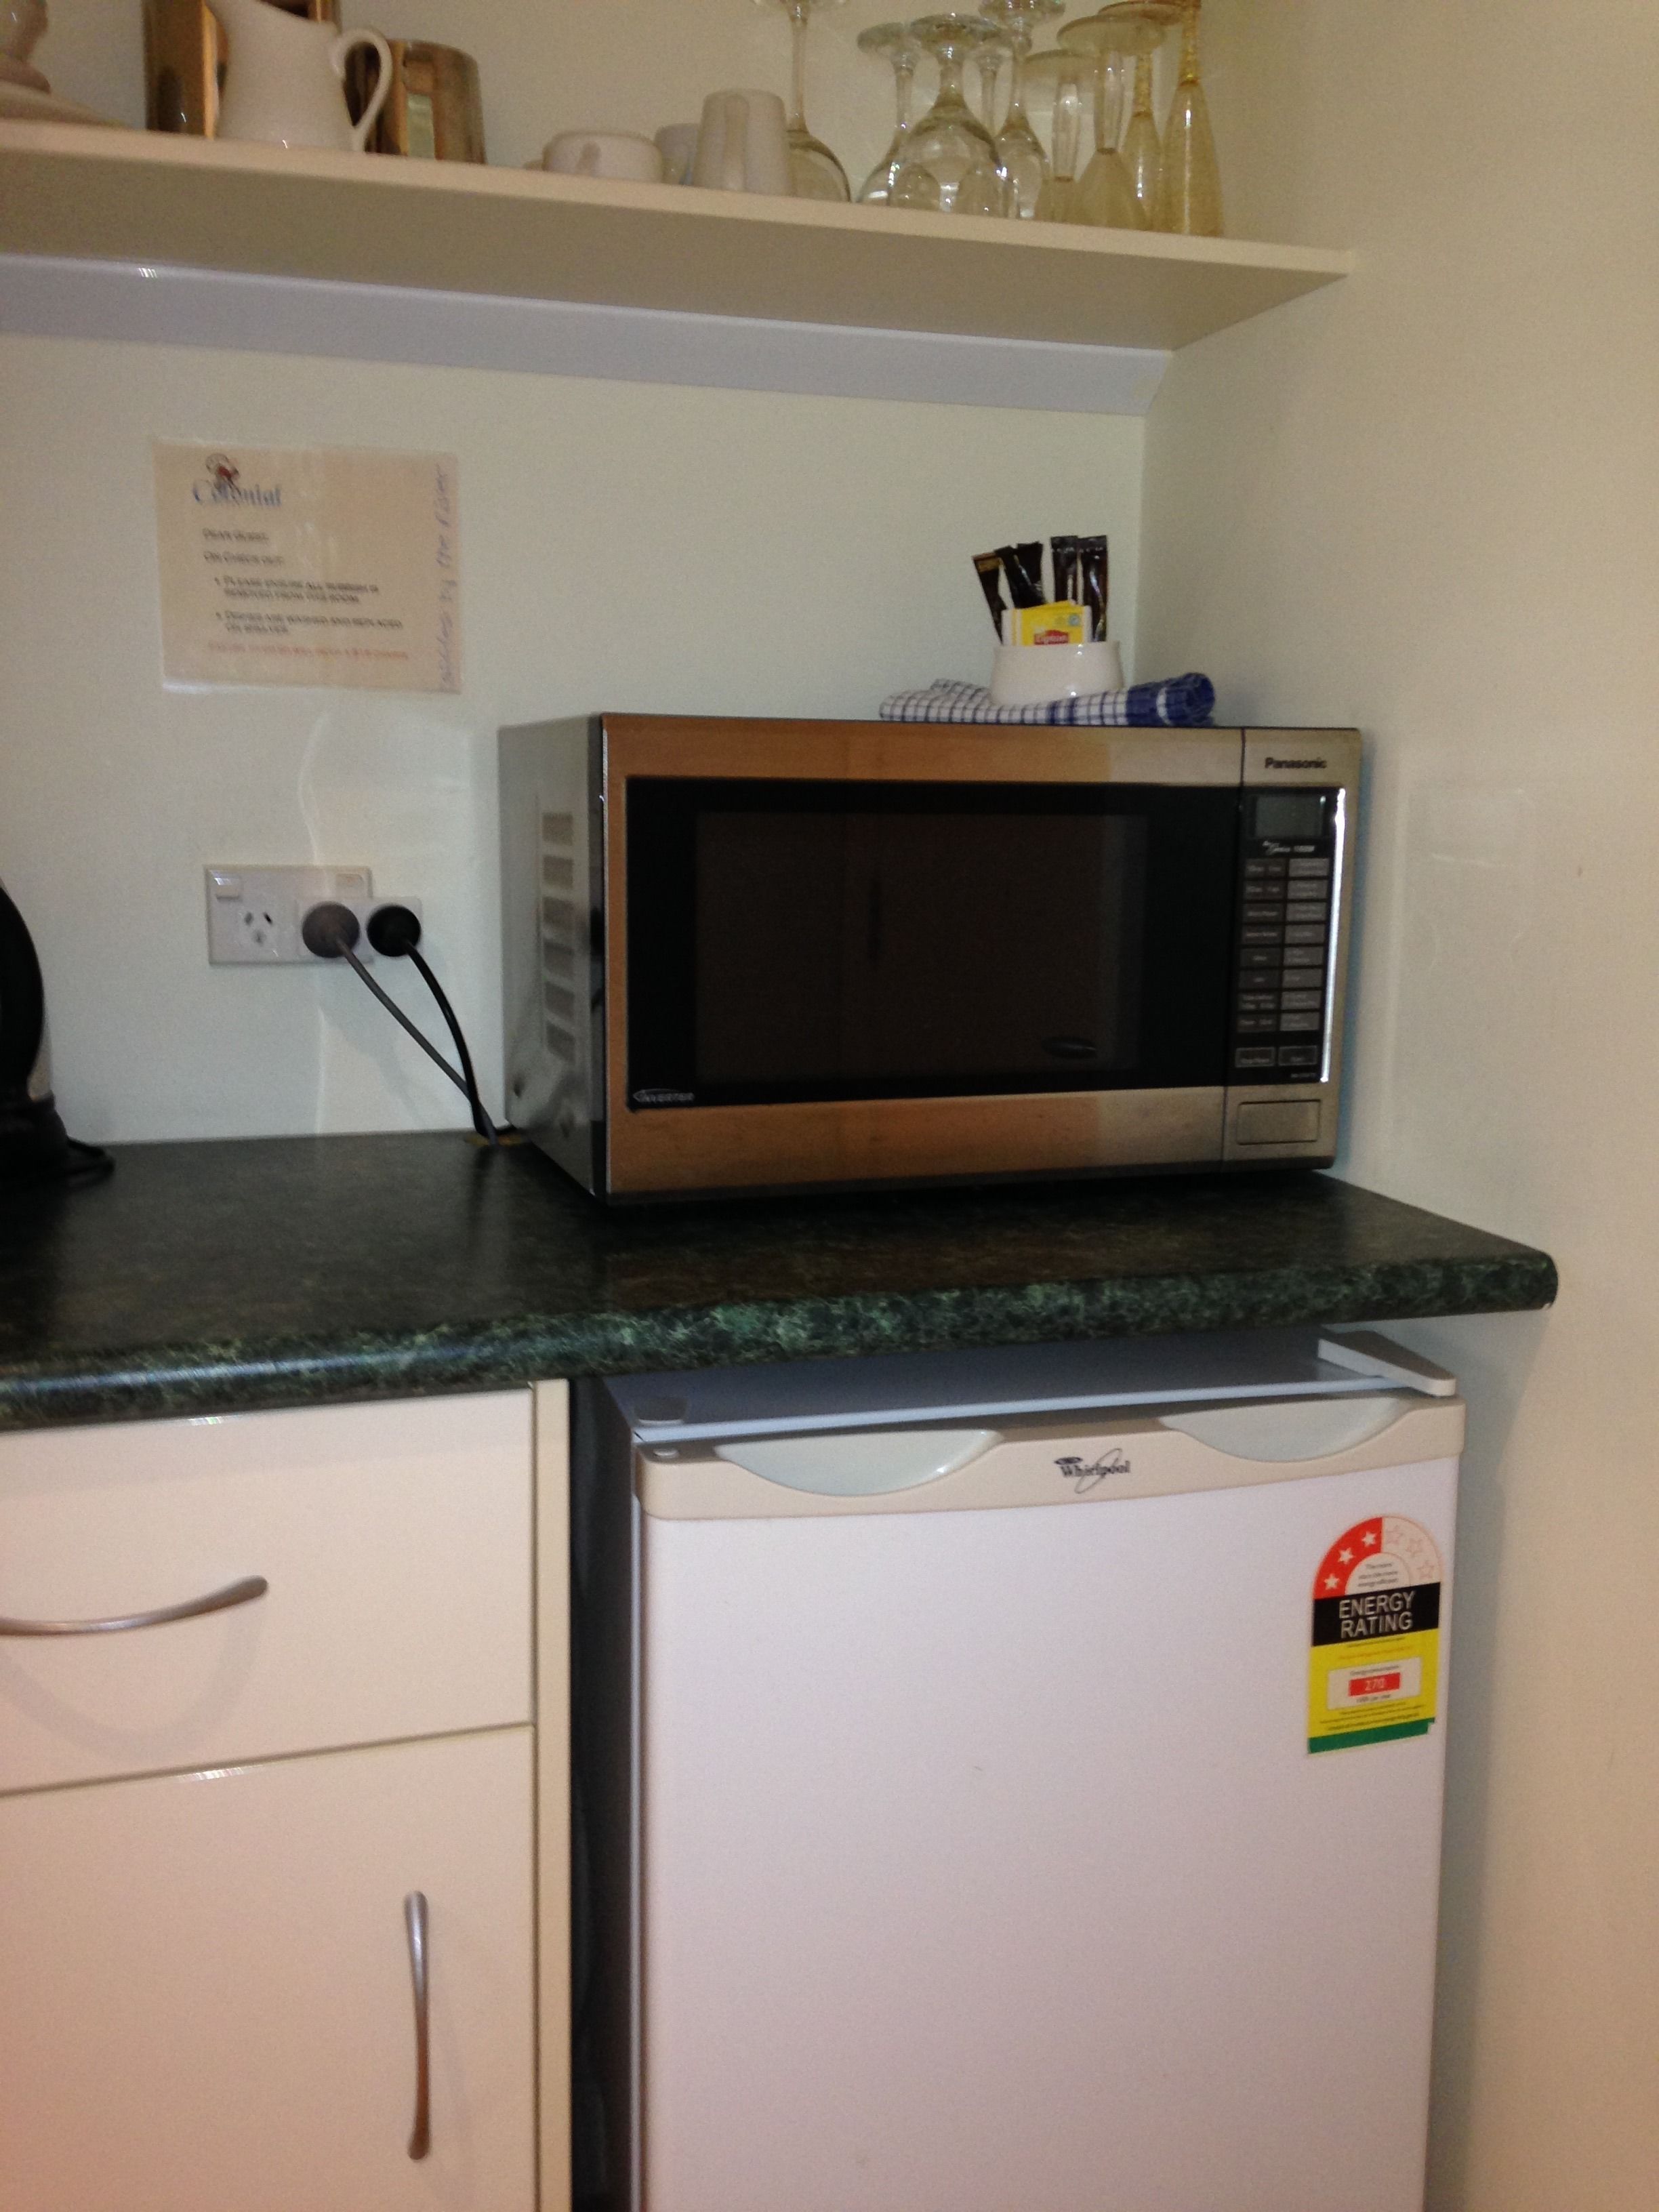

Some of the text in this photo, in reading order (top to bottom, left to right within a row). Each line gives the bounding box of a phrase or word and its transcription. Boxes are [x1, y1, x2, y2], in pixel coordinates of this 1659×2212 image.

[1265, 756, 1327, 769] Panasonic
[1339, 1591, 1416, 1618] ENERGY
[1341, 1612, 1413, 1639] RATING
